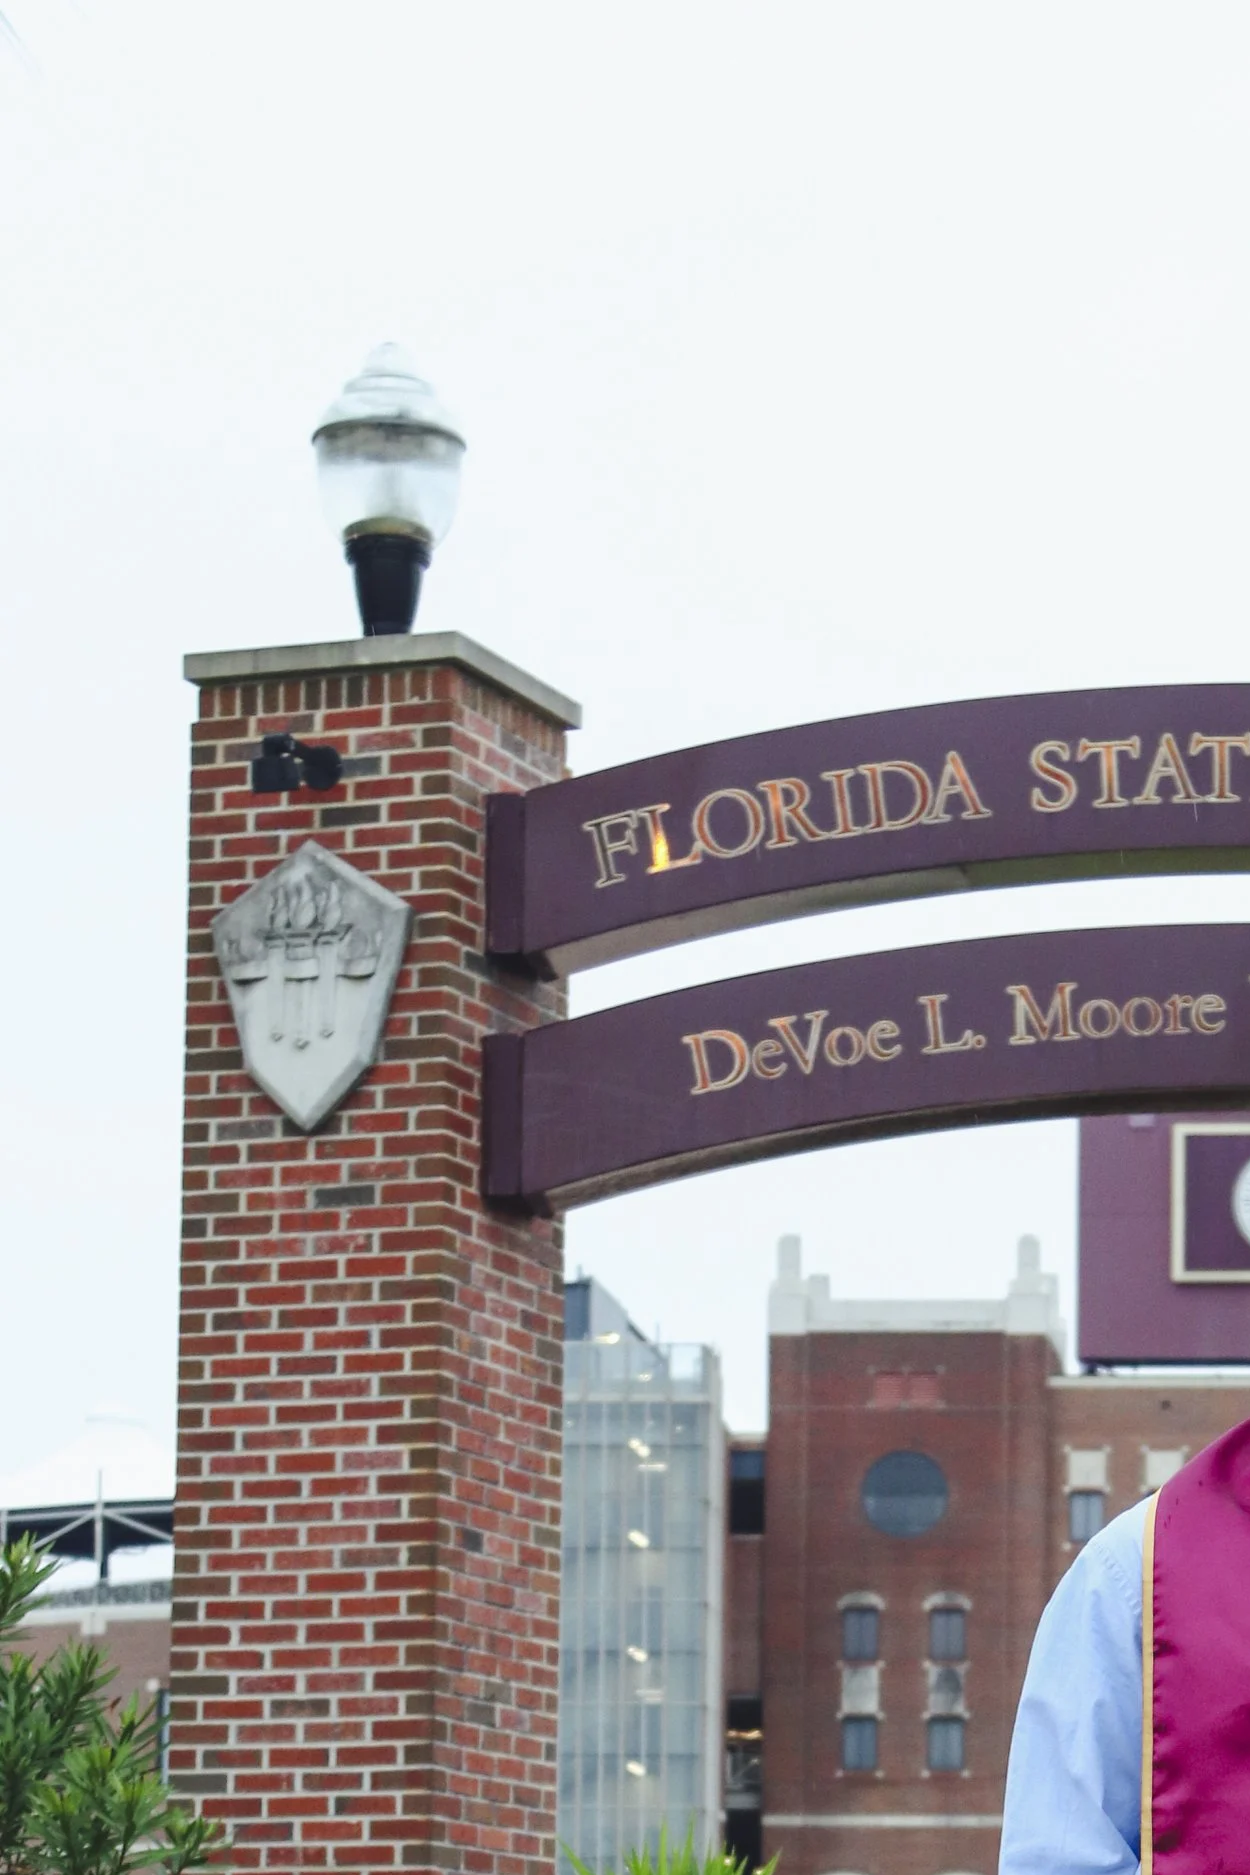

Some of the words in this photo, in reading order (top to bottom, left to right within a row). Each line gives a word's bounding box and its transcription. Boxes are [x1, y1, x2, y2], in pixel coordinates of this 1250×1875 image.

[584, 751, 991, 888] FLORIDA
[682, 1010, 901, 1095] DeVoe
[919, 994, 986, 1054] L.
[1006, 982, 1226, 1046] Moore
